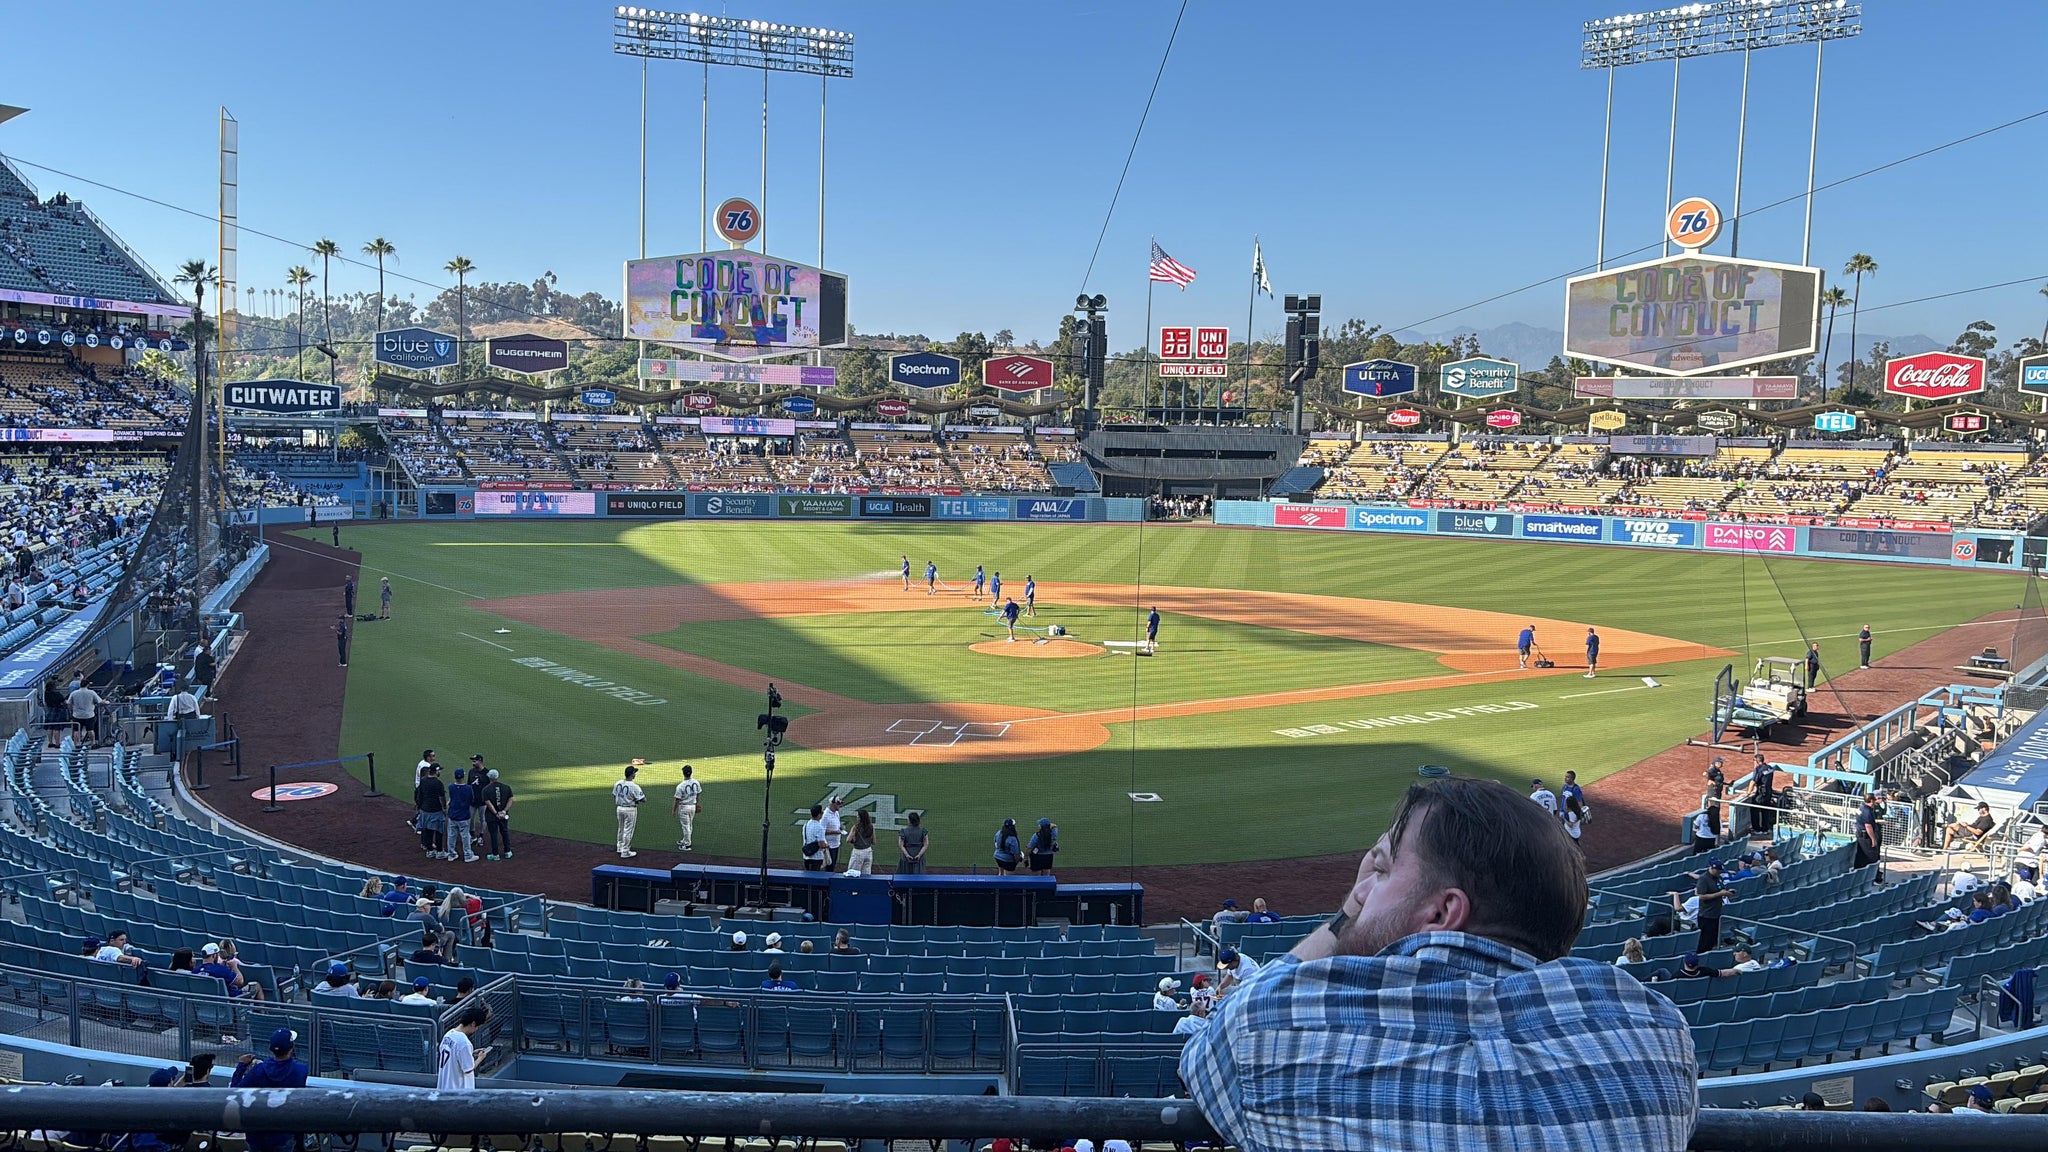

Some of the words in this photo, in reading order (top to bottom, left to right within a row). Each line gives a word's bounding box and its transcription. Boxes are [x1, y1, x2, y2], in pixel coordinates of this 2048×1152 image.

[726, 210, 752, 231] 76
[1677, 209, 1709, 234] 76
[676, 257, 753, 294] CODE
[765, 263, 799, 296] OF
[1615, 264, 1706, 303] CODE
[1713, 262, 1760, 300] OF
[53, 295, 71, 306] CODE
[670, 289, 807, 328] CONDUCT
[1609, 299, 1765, 338] CONDUCT
[87, 335, 98, 346] 53
[1201, 331, 1222, 343] UNI
[383, 334, 429, 354] blue
[1200, 343, 1224, 356] QLO
[390, 353, 435, 363] california
[495, 348, 563, 359] GUGGENHEIM
[899, 363, 950, 377] Spectrum
[1164, 365, 1195, 375] UNIQLO
[1197, 365, 1223, 374] FIELD
[1358, 370, 1400, 381] ULTRA
[1469, 367, 1511, 381] Security
[1893, 362, 1976, 388] Coca-Cola
[1469, 378, 1505, 389] Benefit
[231, 387, 333, 406] CUTWATER
[689, 396, 712, 405] JINRO
[880, 404, 907, 412] Yakult
[1388, 412, 1418, 423] Churu
[1592, 414, 1605, 425] JIM
[1605, 412, 1622, 424] BEAM
[1820, 415, 1851, 429] TEL
[227, 433, 242, 442] 5:26
[458, 500, 472, 510] 76
[500, 494, 521, 503] CODE
[522, 494, 531, 503] OF
[534, 494, 569, 504] CONDUCT
[627, 501, 657, 509] UNIQLO
[659, 501, 683, 509] FIELD
[725, 497, 757, 508] Security
[725, 505, 752, 514] Benefit
[869, 502, 890, 511] UCLA
[895, 502, 925, 512] Health
[940, 500, 972, 516] TEL
[1030, 501, 1057, 513] ANA
[1282, 505, 1300, 513] BANK
[1358, 510, 1418, 527] Spectrum
[1454, 515, 1484, 528] blue
[1526, 521, 1598, 535] smartwater
[1624, 520, 1670, 533] TOYO
[1631, 533, 1679, 545] TIRES
[1713, 527, 1766, 540] DAISO
[1955, 544, 1972, 555] 76
[1340, 708, 1456, 730] UNIQLO
[1449, 701, 1541, 716] FIELD
[1543, 800, 1550, 811] 5
[440, 1048, 450, 1069] 17
